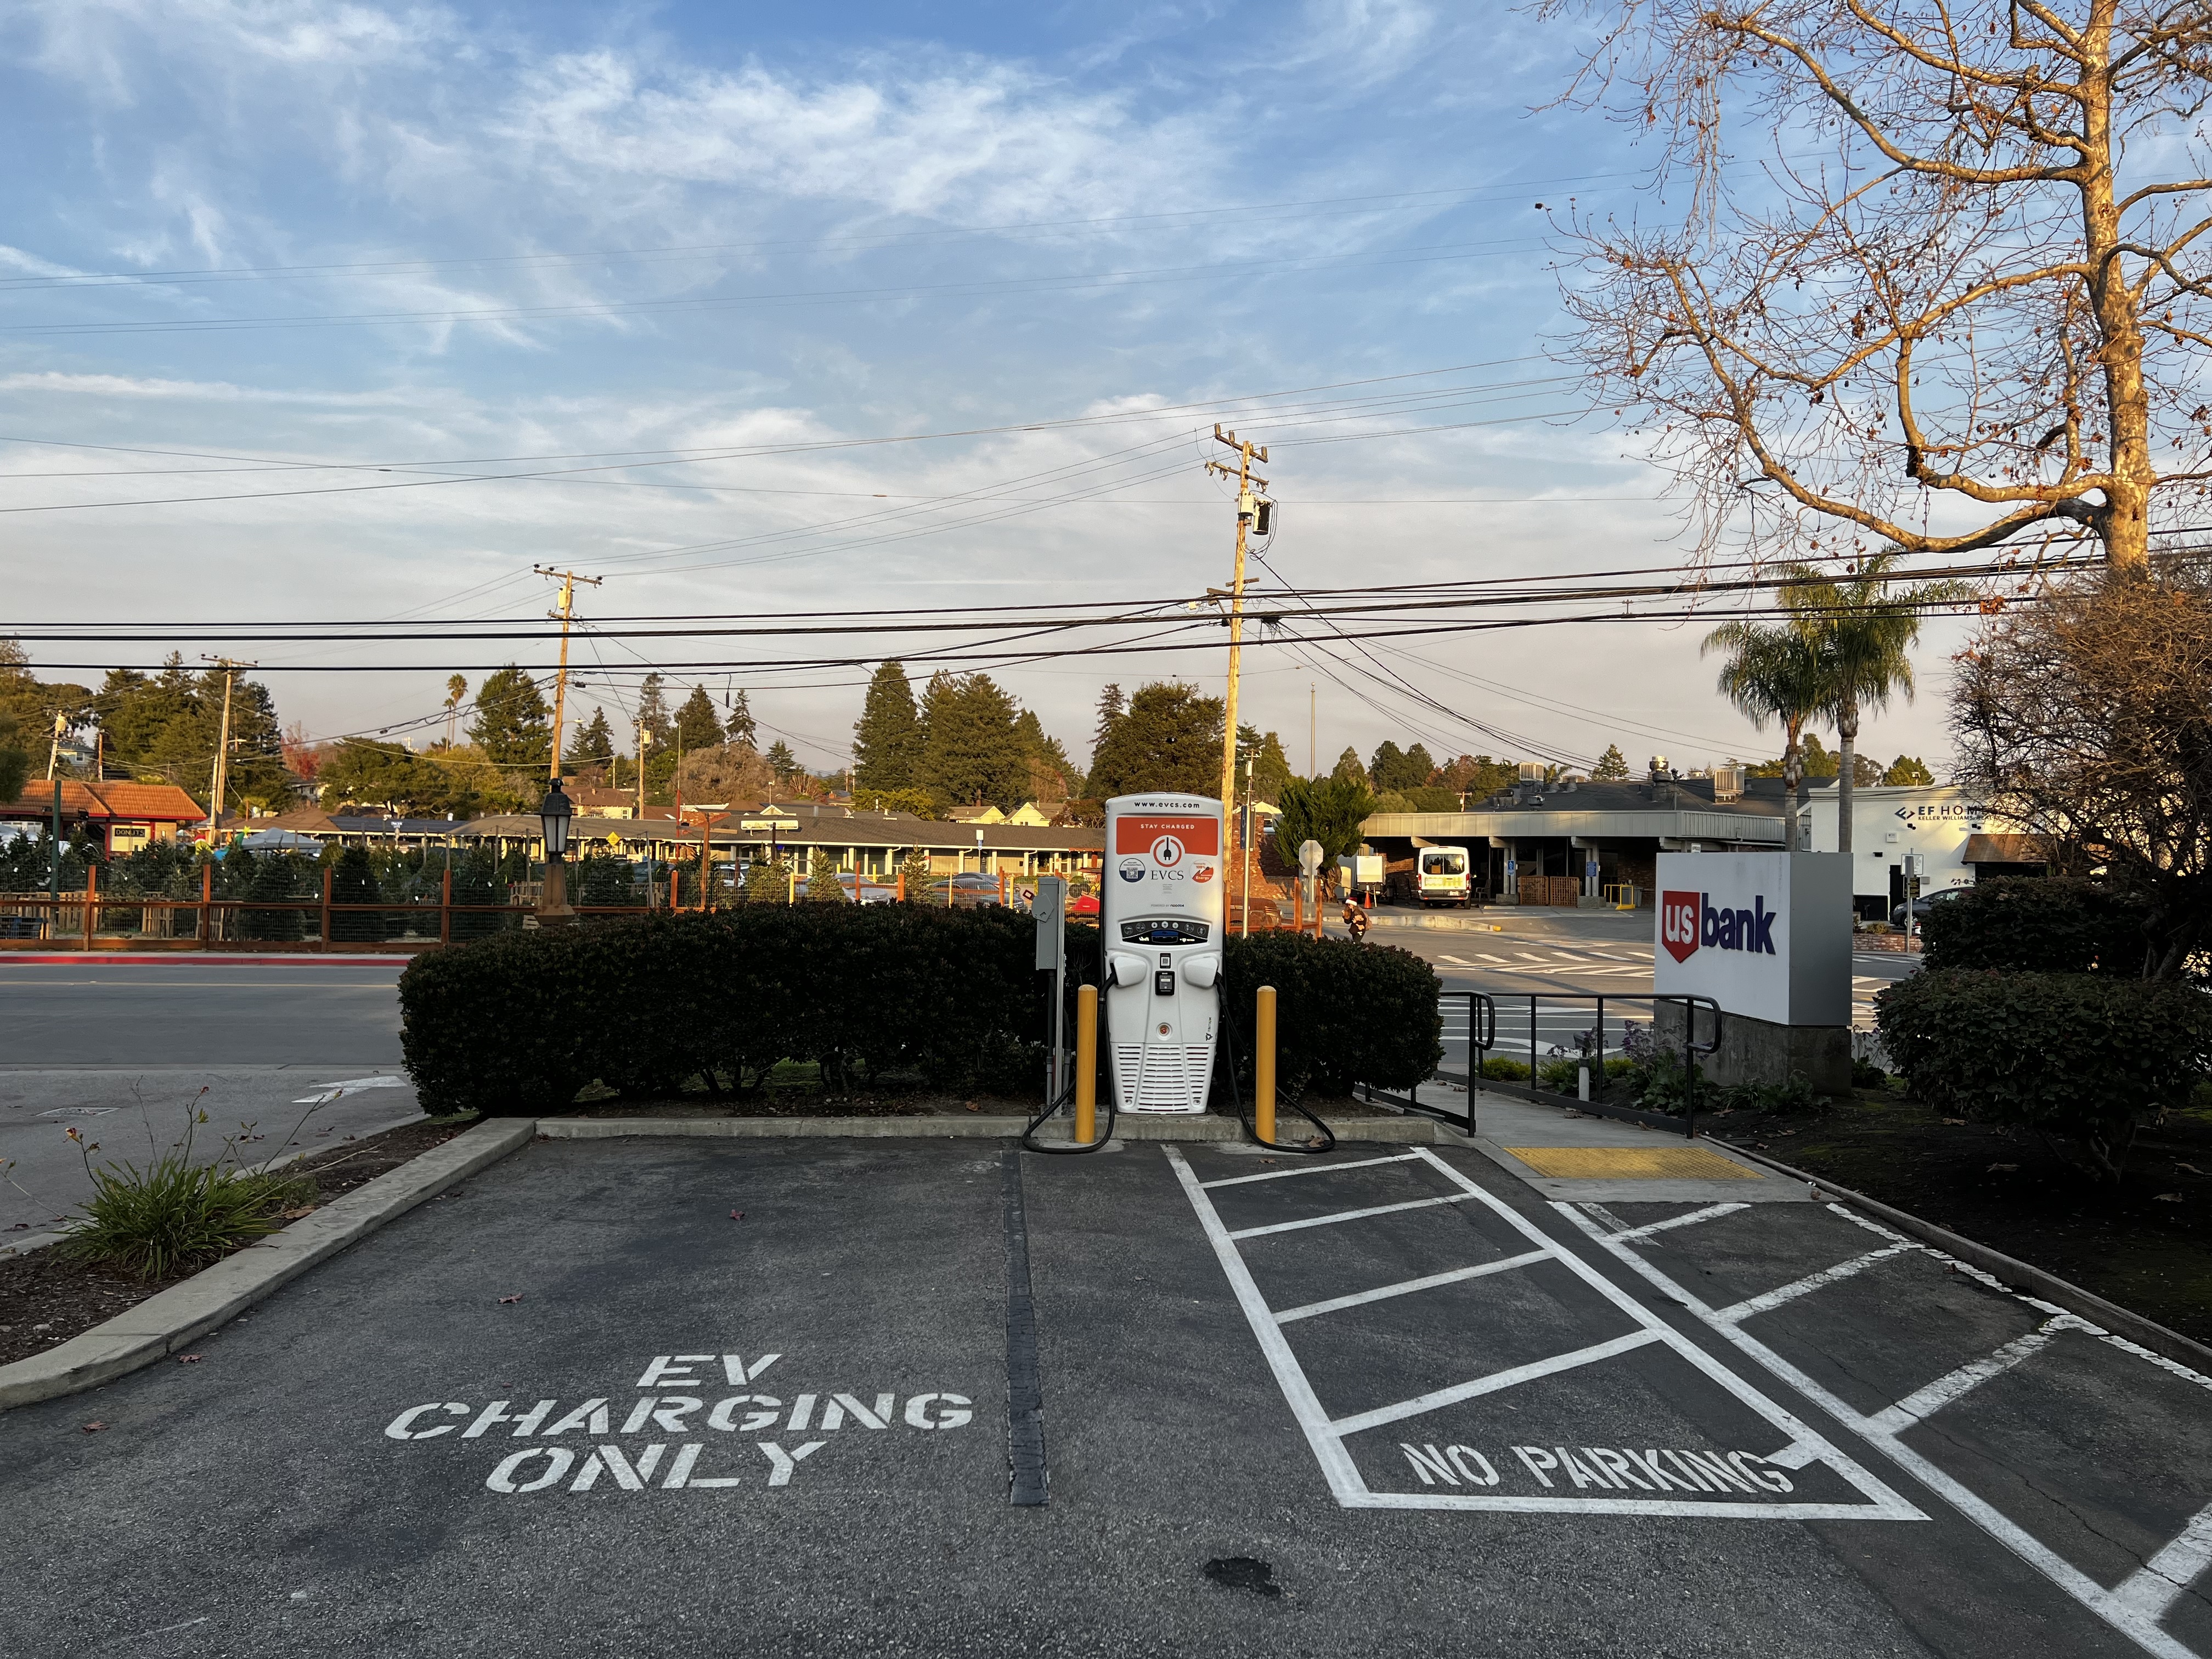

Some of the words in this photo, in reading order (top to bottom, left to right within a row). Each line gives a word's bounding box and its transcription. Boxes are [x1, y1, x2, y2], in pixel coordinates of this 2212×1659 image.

[1918, 806, 1934, 815] EF
[1150, 870, 1184, 881] EVCS
[1664, 904, 1694, 945] us
[1701, 892, 1777, 956] bank
[636, 1353, 782, 1387] EV
[385, 1393, 973, 1440] CHARGING
[486, 1441, 828, 1493] ONLY
[1400, 1443, 1500, 1486] NO
[1511, 1446, 1795, 1493] PARKING
